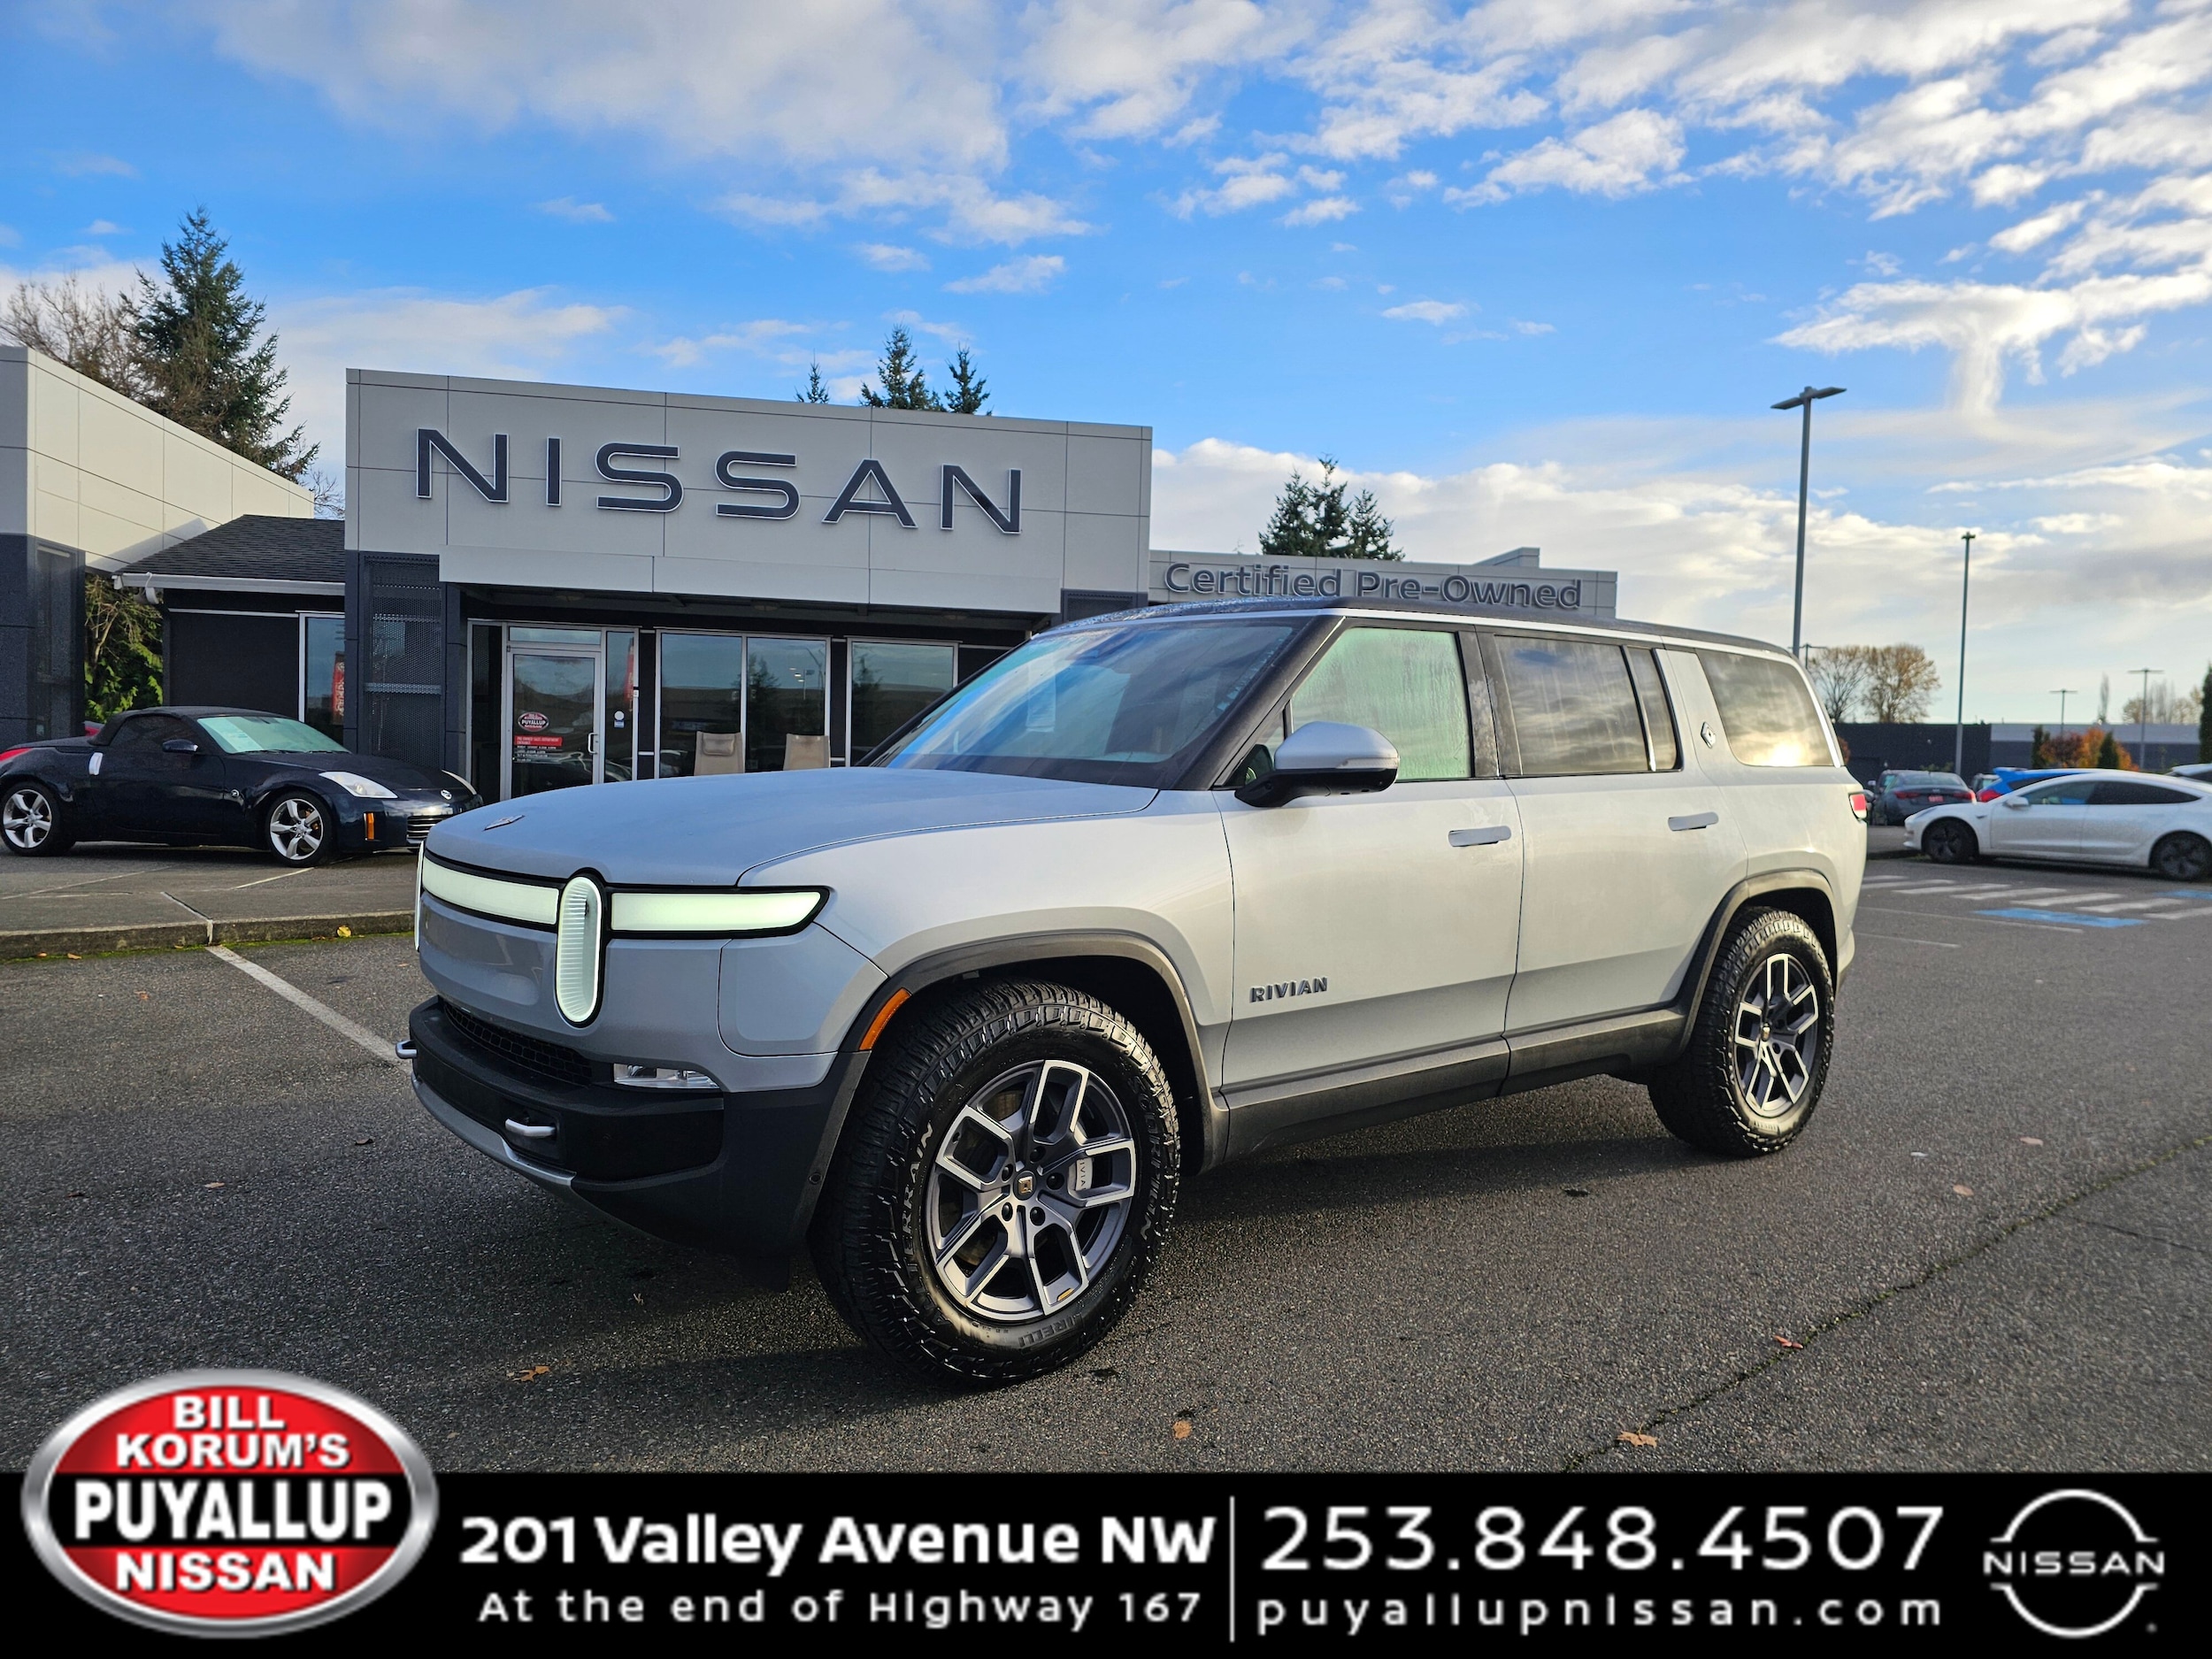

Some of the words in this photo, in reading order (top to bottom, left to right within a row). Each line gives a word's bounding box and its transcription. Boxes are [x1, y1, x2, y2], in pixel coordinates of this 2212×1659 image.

[416, 427, 1021, 534] NISSAN
[1164, 562, 1342, 598] Certified
[1357, 571, 1582, 610] Pre-Owned
[1250, 977, 1328, 1002] RIVIAN
